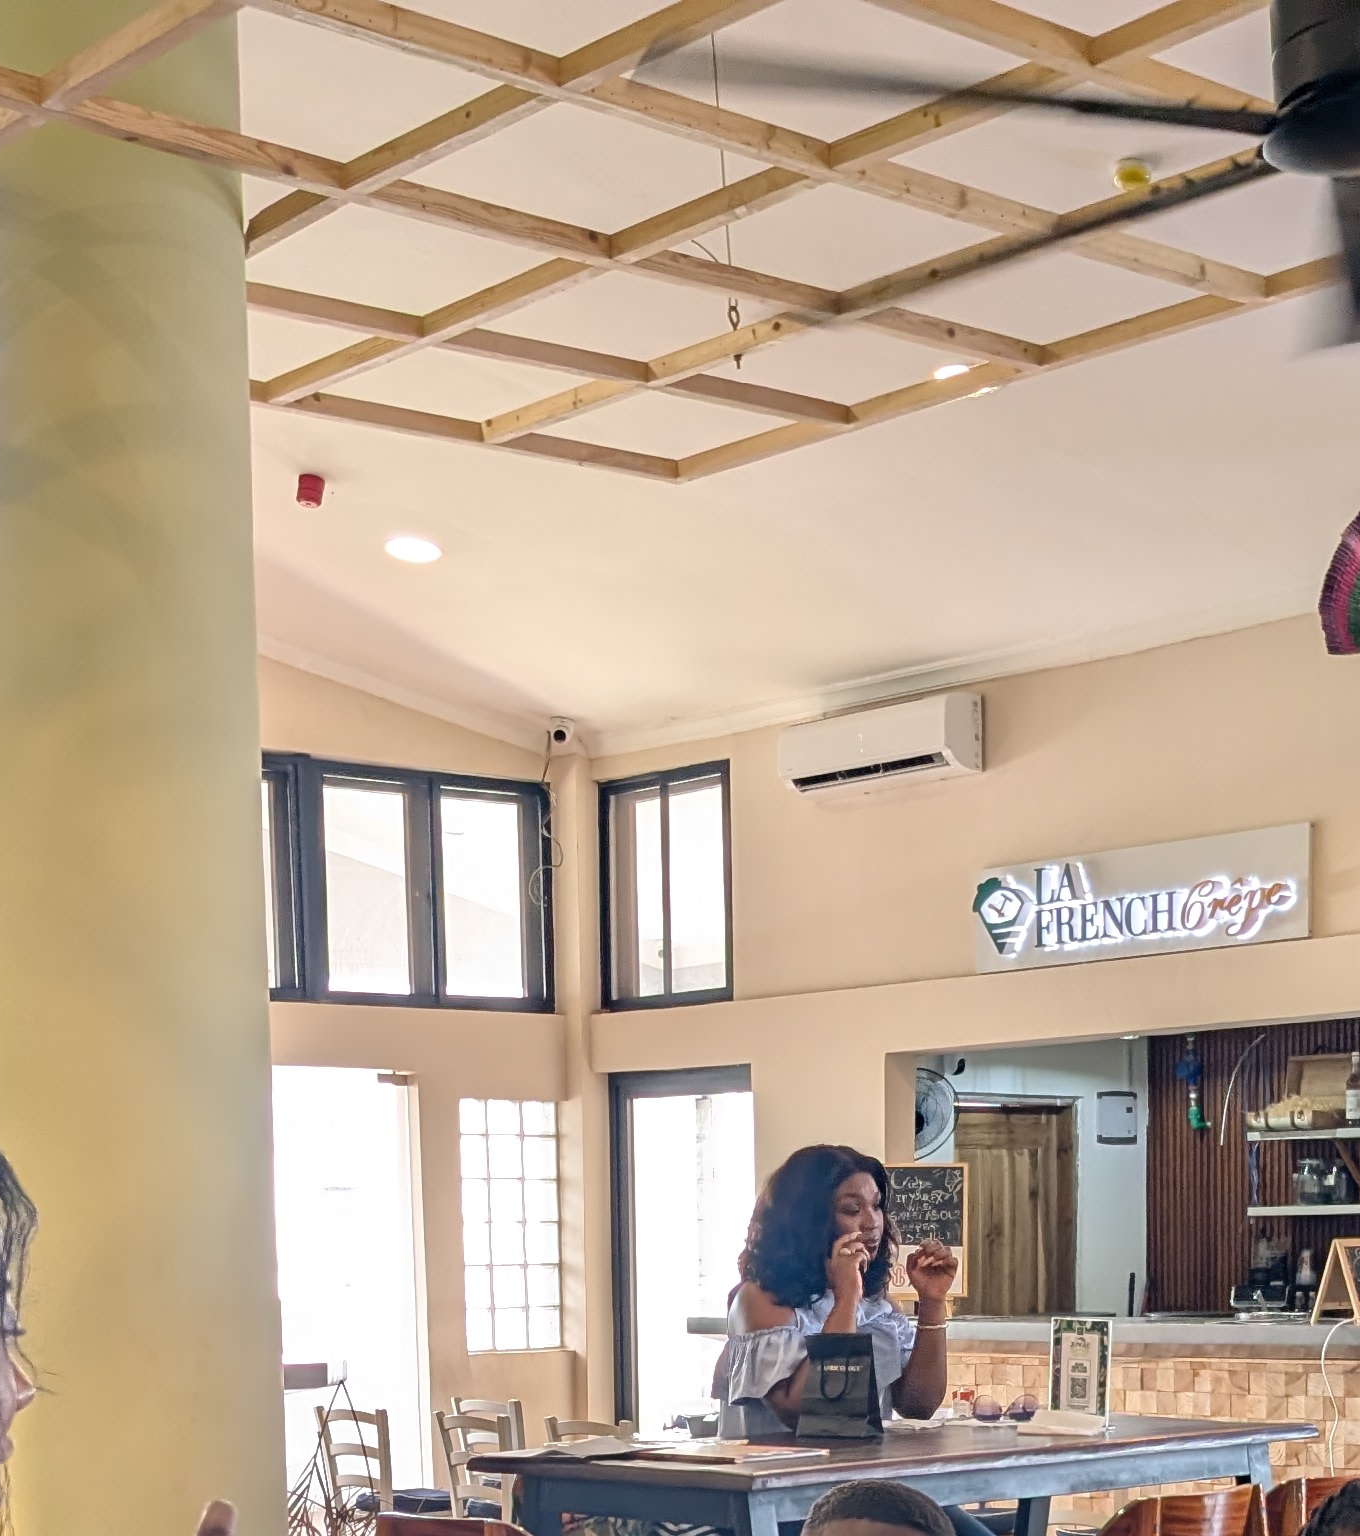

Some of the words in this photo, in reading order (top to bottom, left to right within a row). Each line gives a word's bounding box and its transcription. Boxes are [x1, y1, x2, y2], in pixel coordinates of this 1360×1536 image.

[1034, 863, 1081, 906] LA
[1034, 889, 1183, 949] FRENCH
[1180, 877, 1292, 937] Crêpe
